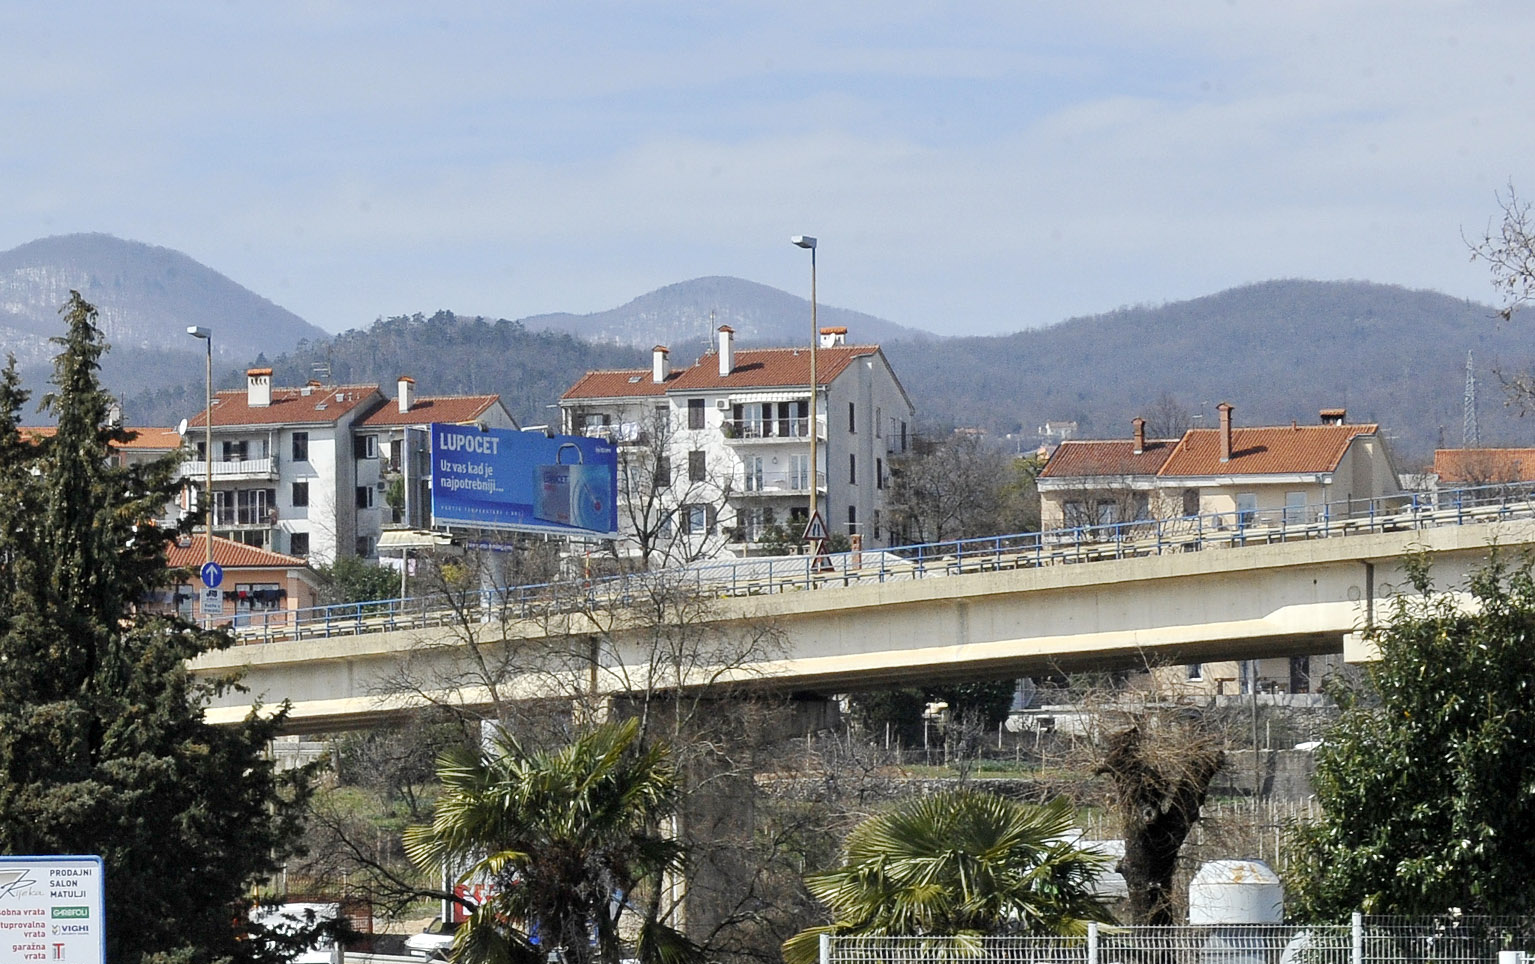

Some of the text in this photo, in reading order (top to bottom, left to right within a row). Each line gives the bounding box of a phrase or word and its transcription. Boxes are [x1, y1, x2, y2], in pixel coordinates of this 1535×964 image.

[440, 432, 499, 454] LUPOCET
[440, 460, 493, 478] Uz vas kad je
[440, 476, 504, 494] najpotrebniji...
[24, 908, 46, 916] vrata
[12, 943, 46, 952] garažna
